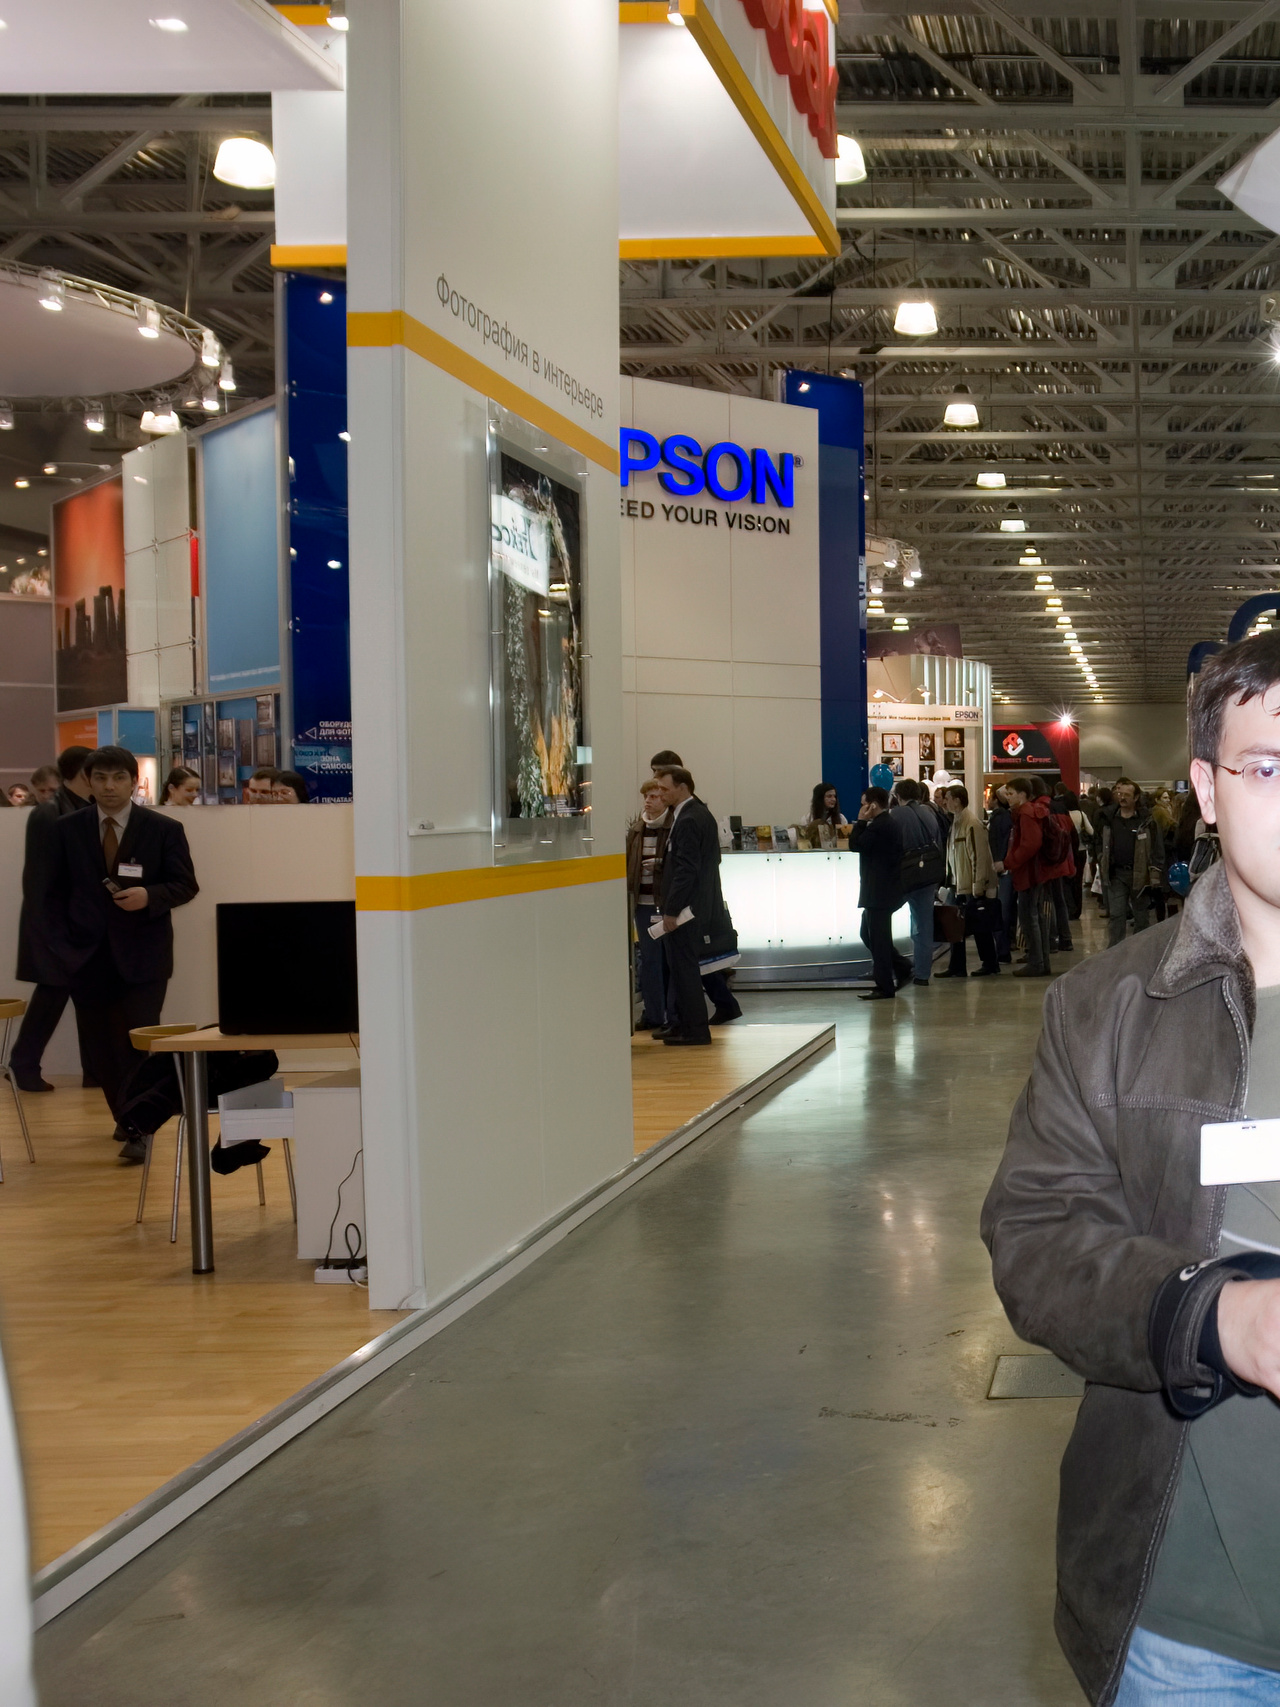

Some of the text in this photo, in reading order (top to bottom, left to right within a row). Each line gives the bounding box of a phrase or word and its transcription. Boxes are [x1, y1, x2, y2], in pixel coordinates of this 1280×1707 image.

[437, 273, 603, 419] Фотография в интерьере
[661, 503, 718, 527] YOUR
[725, 512, 791, 535] VISION
[955, 710, 979, 719] EPSON
